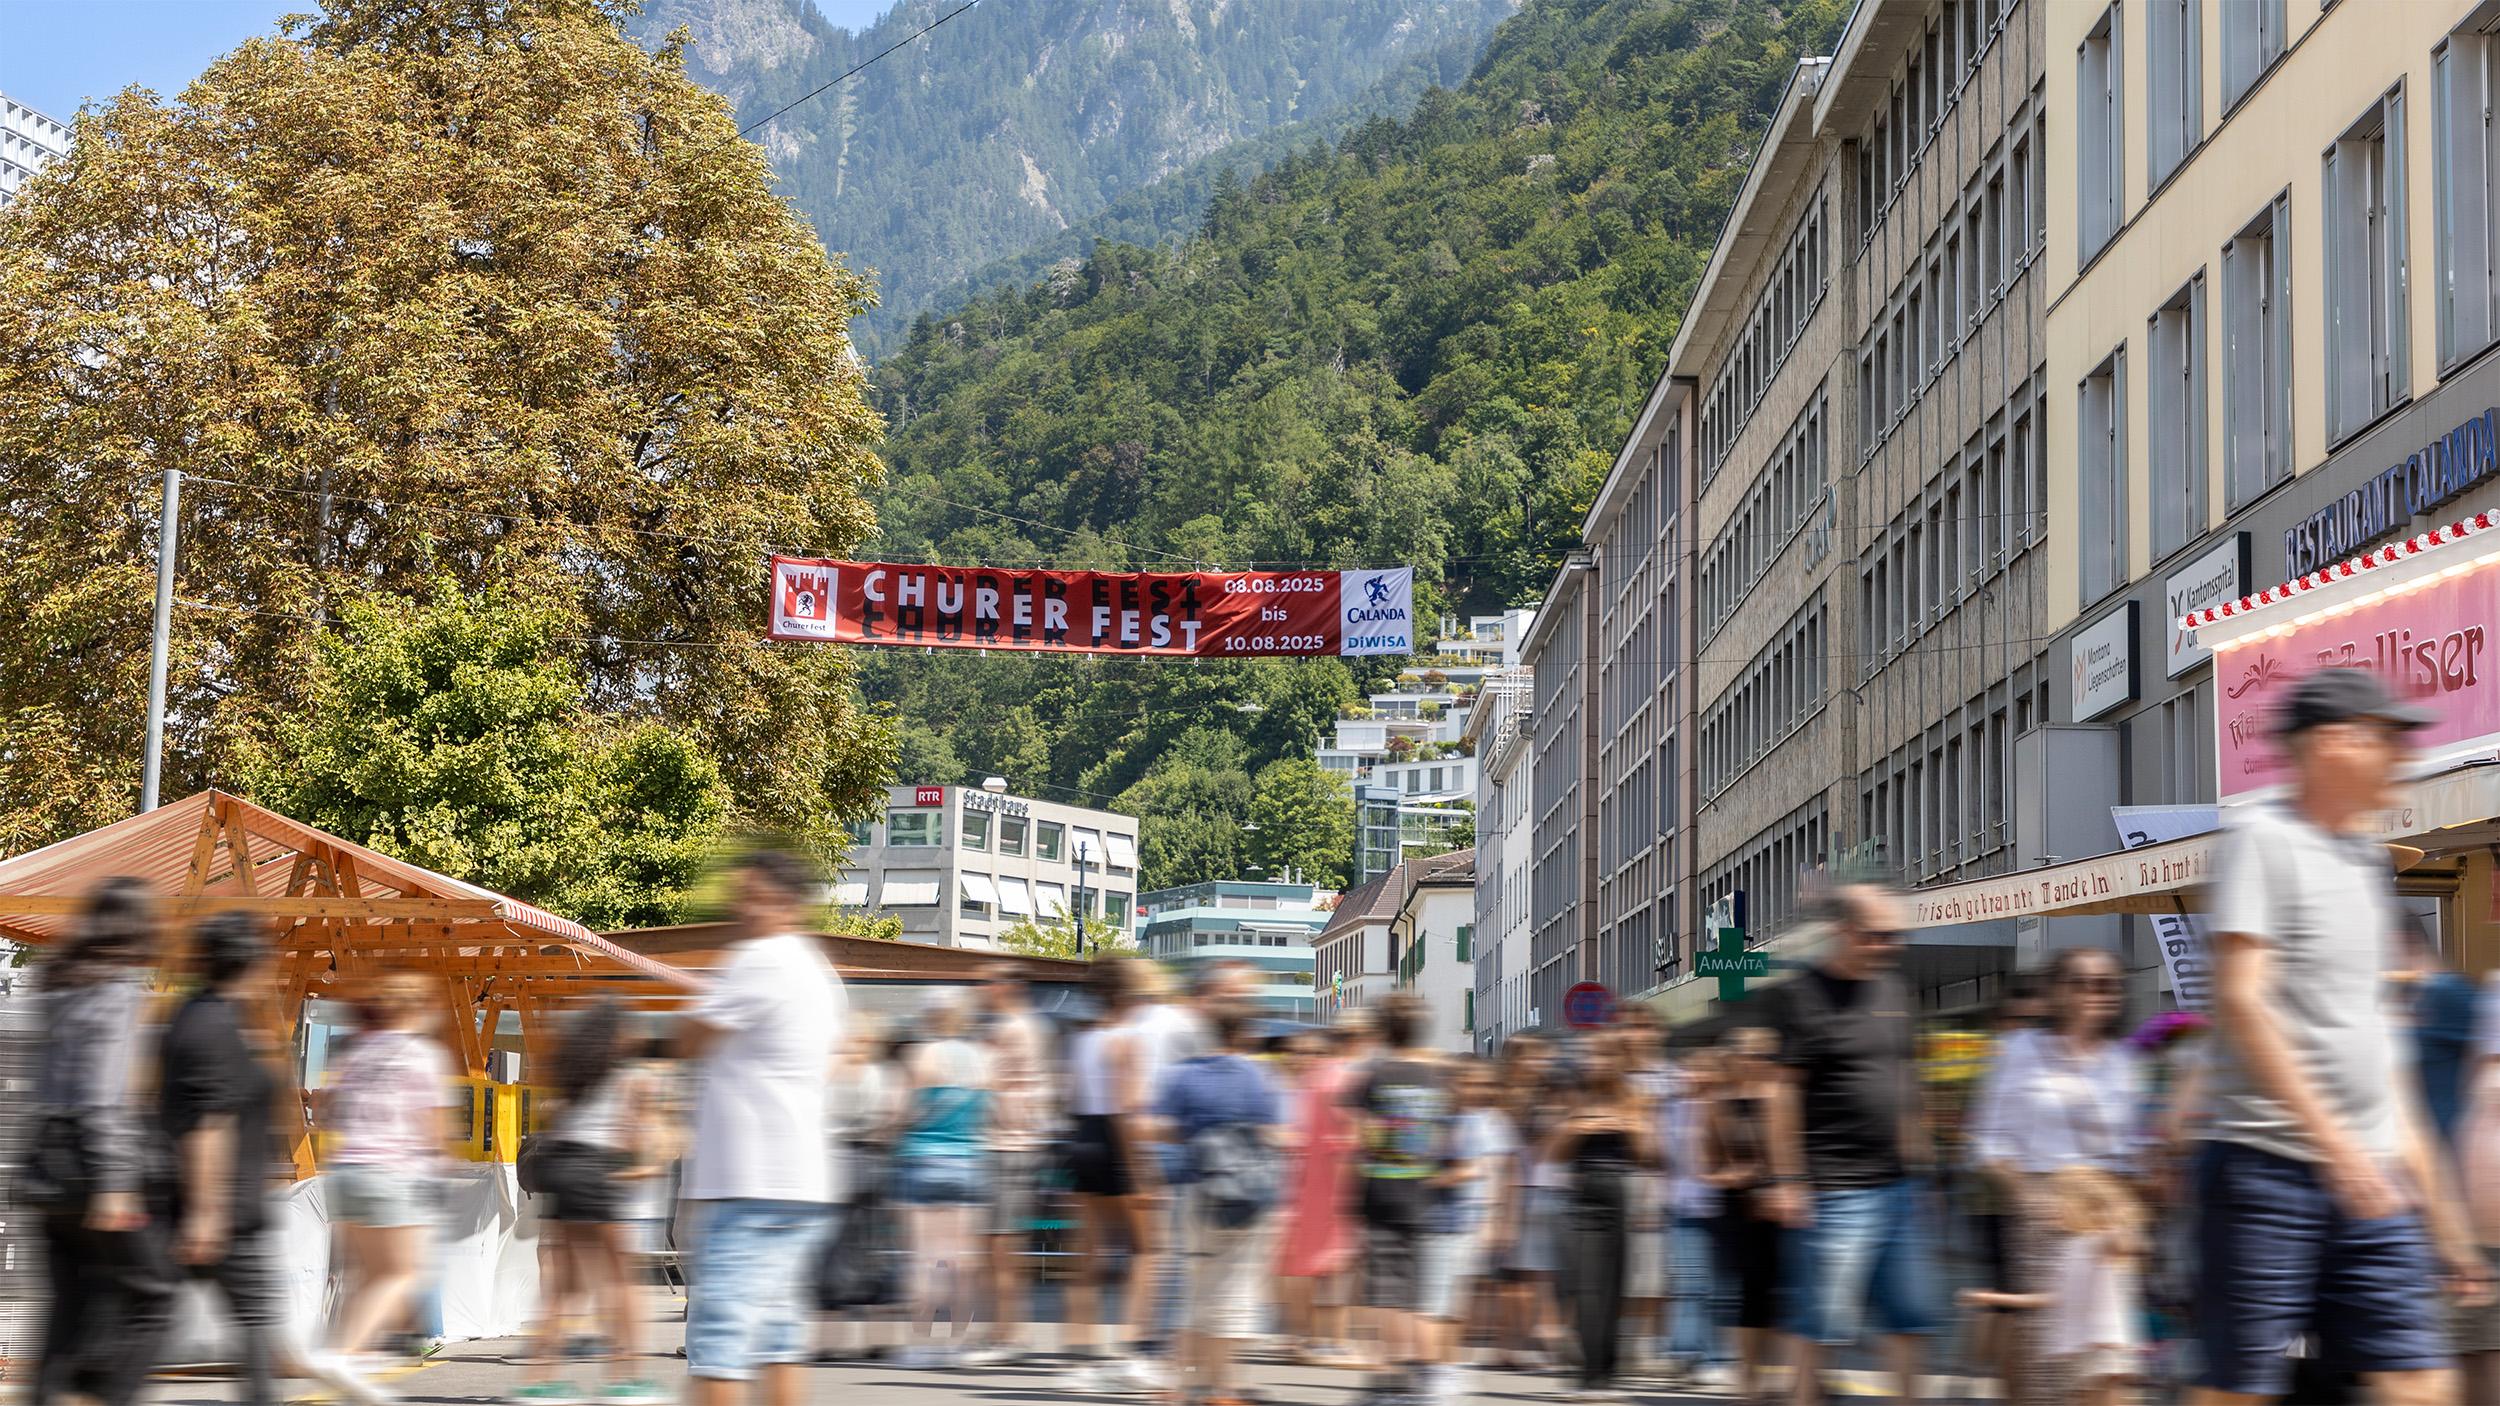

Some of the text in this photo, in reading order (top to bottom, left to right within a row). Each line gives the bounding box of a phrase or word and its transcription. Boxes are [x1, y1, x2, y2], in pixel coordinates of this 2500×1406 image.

[2285, 407, 2498, 583] RESTAURANT CALANDA
[1224, 577, 1325, 594] 08.08.2025
[2186, 558, 2235, 611] Kantonsspital
[863, 569, 1203, 652] CHURER FEST
[1261, 605, 1288, 622] bis
[1346, 607, 1407, 624] CALANDA
[782, 620, 827, 632] Churer Fest
[1224, 635, 1325, 651] 10.08.2025
[2087, 642, 2111, 668] Montana
[2087, 656, 2127, 693] Liegenschaften
[918, 791, 940, 802] RTR
[963, 789, 1029, 813] Stadthaus
[1916, 897, 1962, 922] frisch
[1698, 955, 1766, 973] AMAVITA
